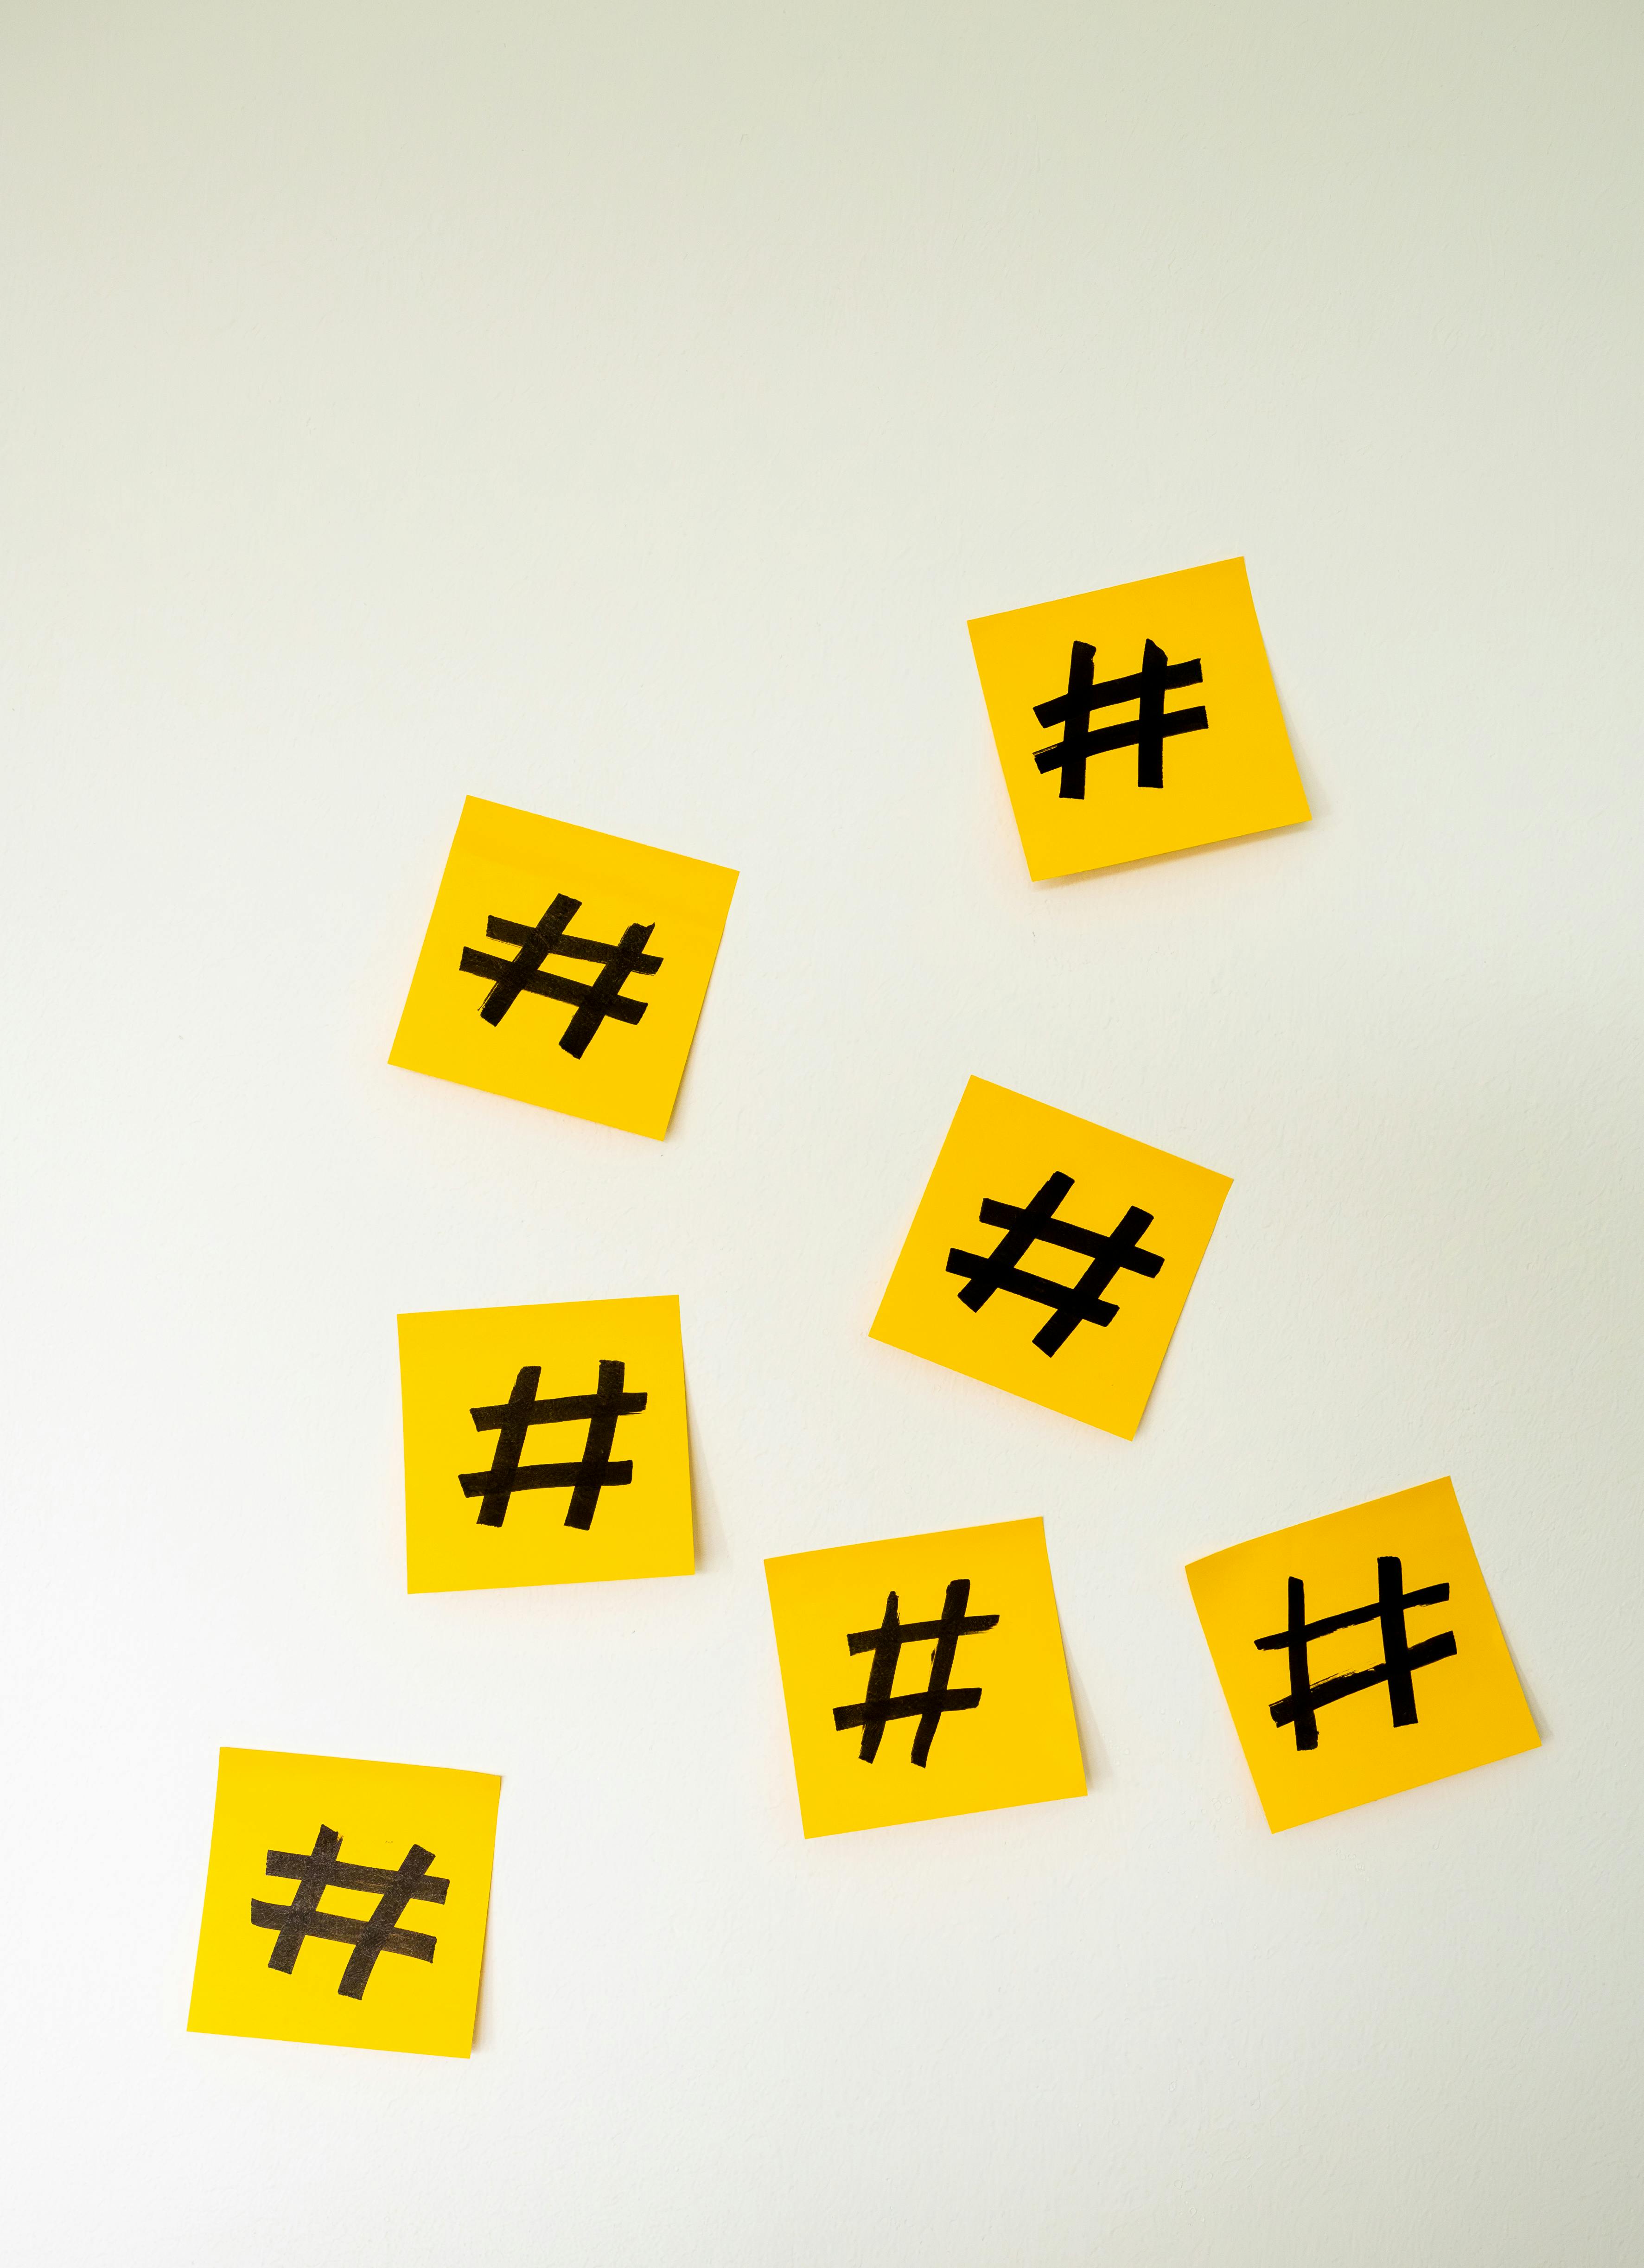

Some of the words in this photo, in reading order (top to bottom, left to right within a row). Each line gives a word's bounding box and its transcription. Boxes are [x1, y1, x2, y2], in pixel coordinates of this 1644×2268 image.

[1033, 639, 1209, 799] #
[459, 893, 663, 1060] #
[946, 1171, 1165, 1358] #
[458, 1360, 647, 1530] #
[833, 1579, 1000, 1768] #
[1254, 1556, 1457, 1751] #
[251, 1824, 450, 2000] #
